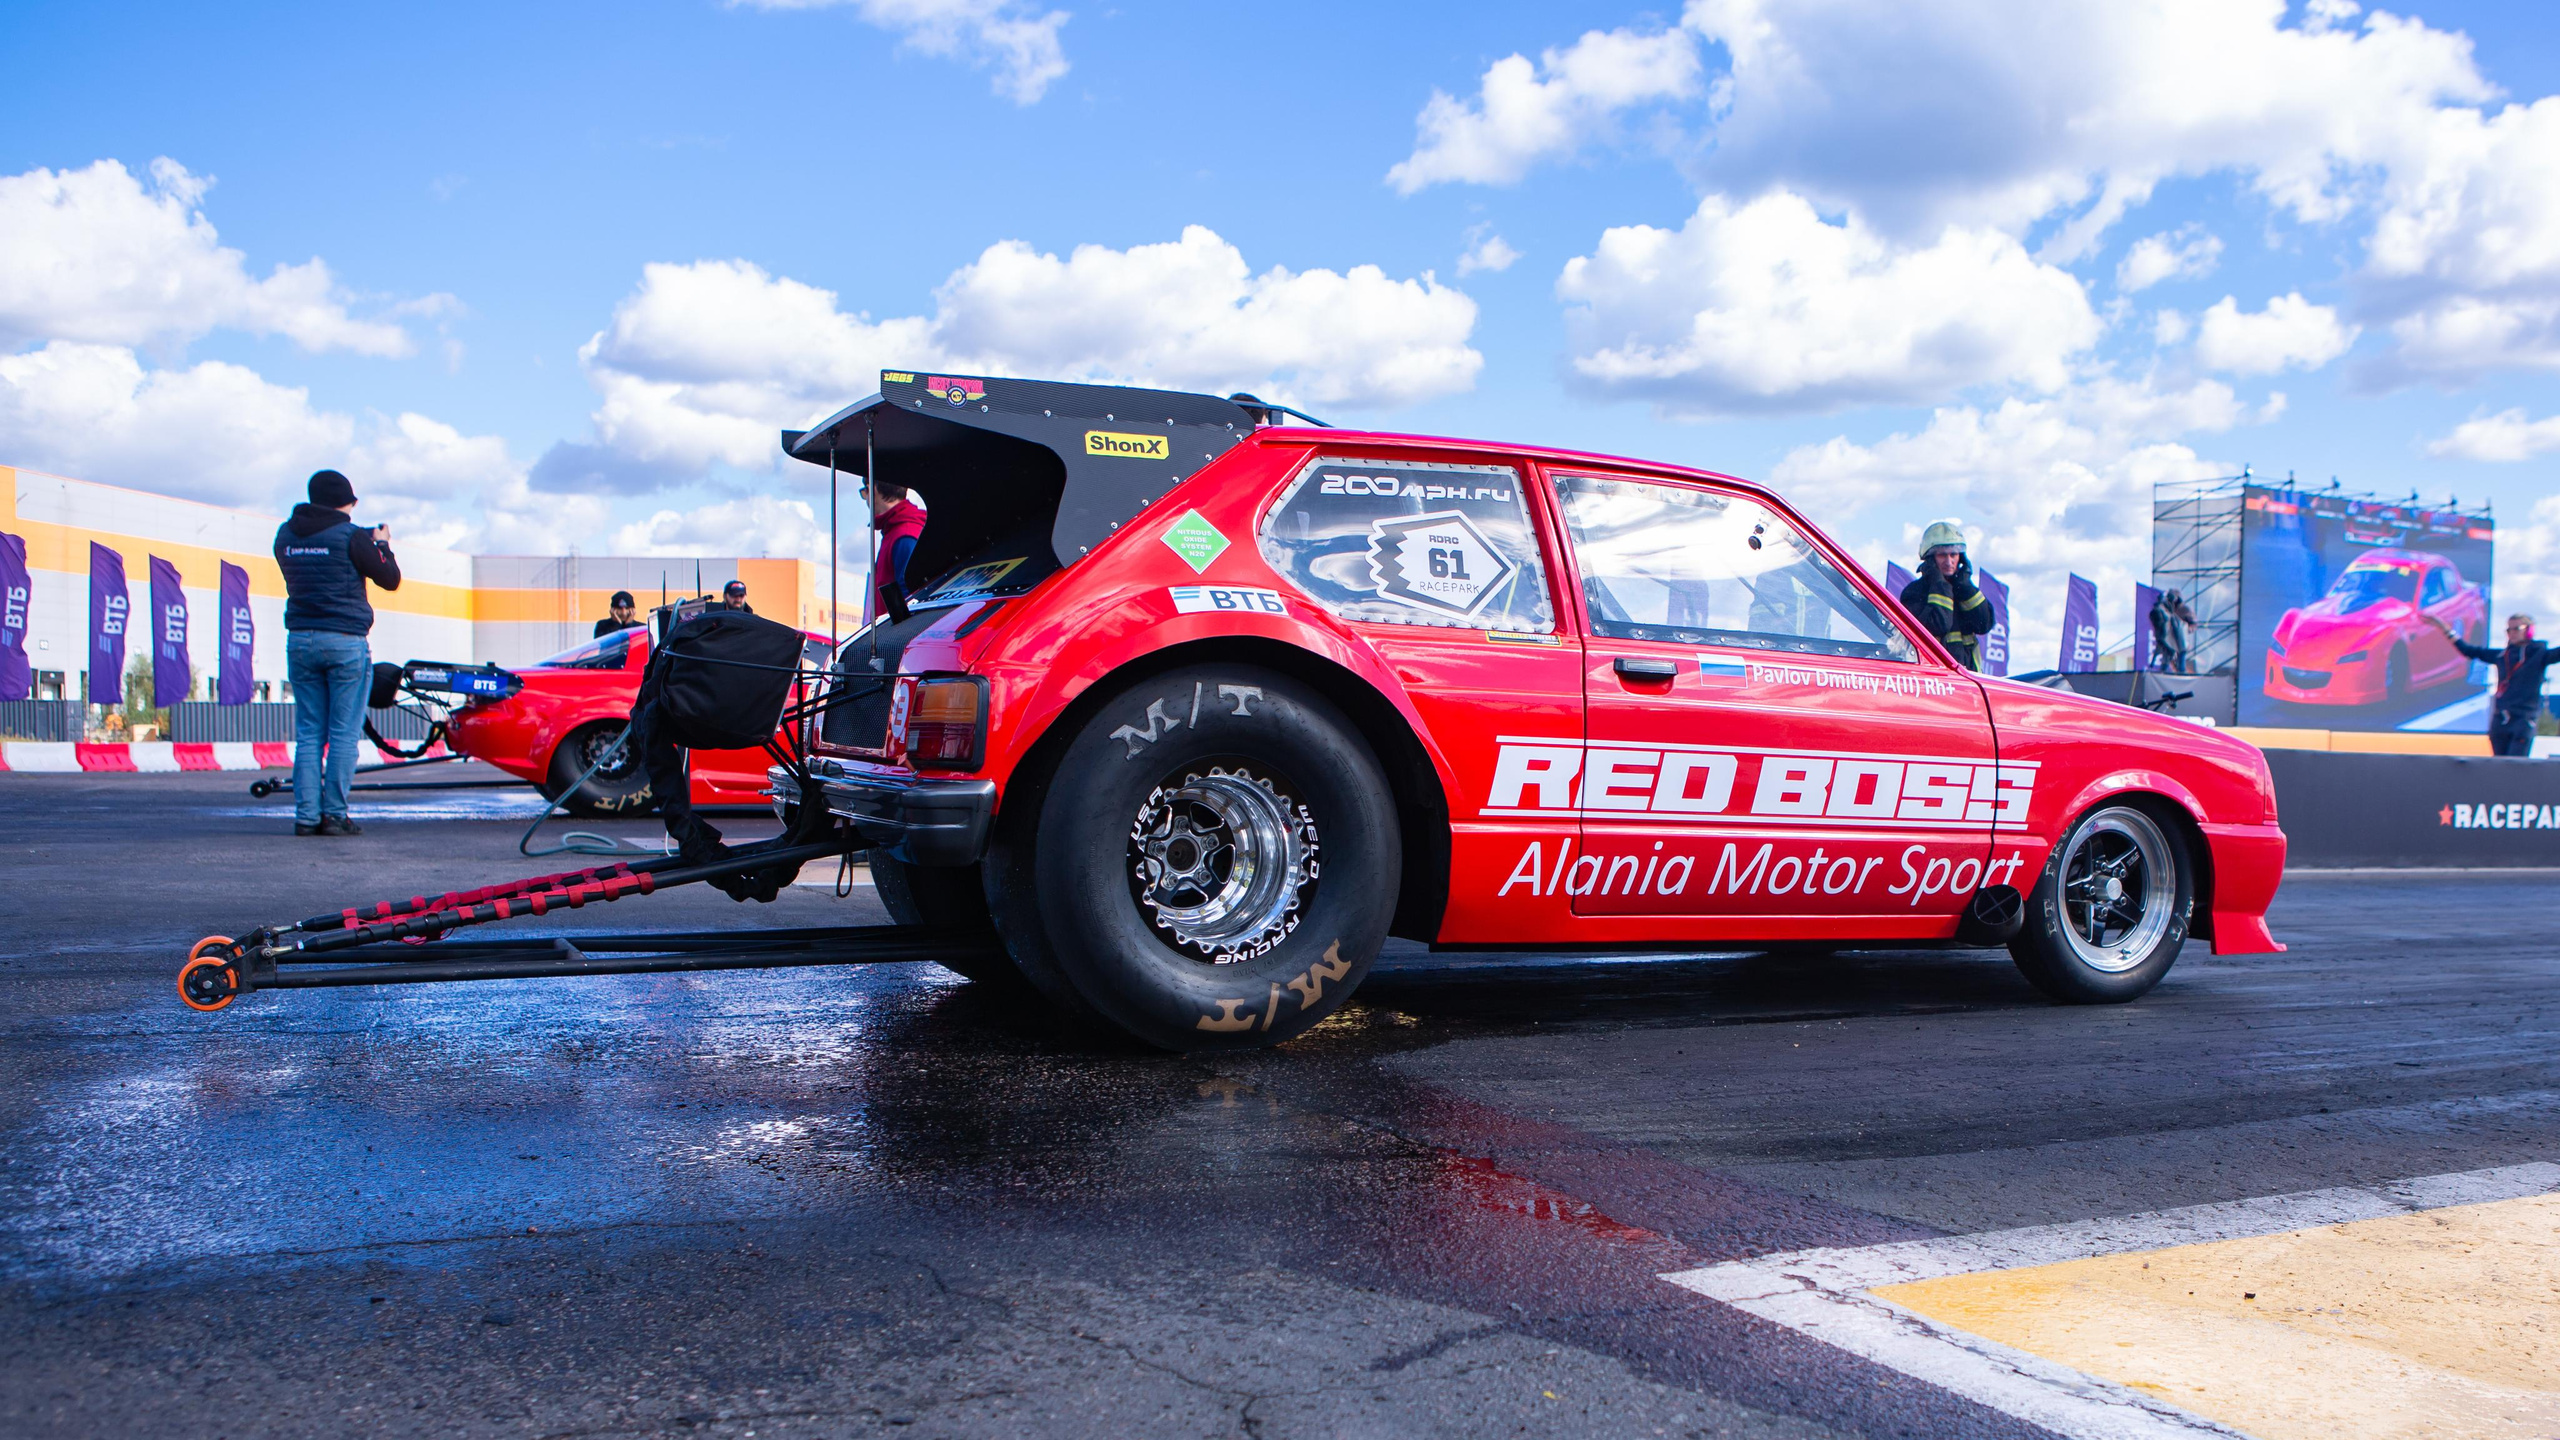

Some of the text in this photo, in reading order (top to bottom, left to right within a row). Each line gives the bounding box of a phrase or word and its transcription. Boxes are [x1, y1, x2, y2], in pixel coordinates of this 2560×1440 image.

[884, 372, 914, 384] JEGS
[1090, 435, 1162, 454] ShonX
[1428, 534, 1460, 545] RDRC
[1428, 547, 1471, 580] 61
[1209, 590, 1284, 613] ВТБ
[1419, 581, 1480, 594] RACEPARK
[5, 586, 27, 629] ВТБ
[103, 595, 127, 635] ВТБ
[165, 604, 186, 643] ВТБ
[231, 607, 252, 645] ВТБ
[2074, 624, 2097, 662] ВТБ
[473, 679, 498, 691] ВТБ
[1752, 664, 1811, 686] Pavlov
[1816, 671, 1879, 694] Dmitriy
[1925, 677, 1956, 696] Rh+
[1108, 680, 1264, 761] M/T
[1487, 745, 2037, 822] RED BOSS
[1130, 786, 1163, 841] USA
[1297, 804, 1320, 880] WELD
[1497, 838, 2025, 906] Alania Motor Sport
[1214, 914, 1301, 964] RACING
[1196, 937, 1352, 1032] M/T
